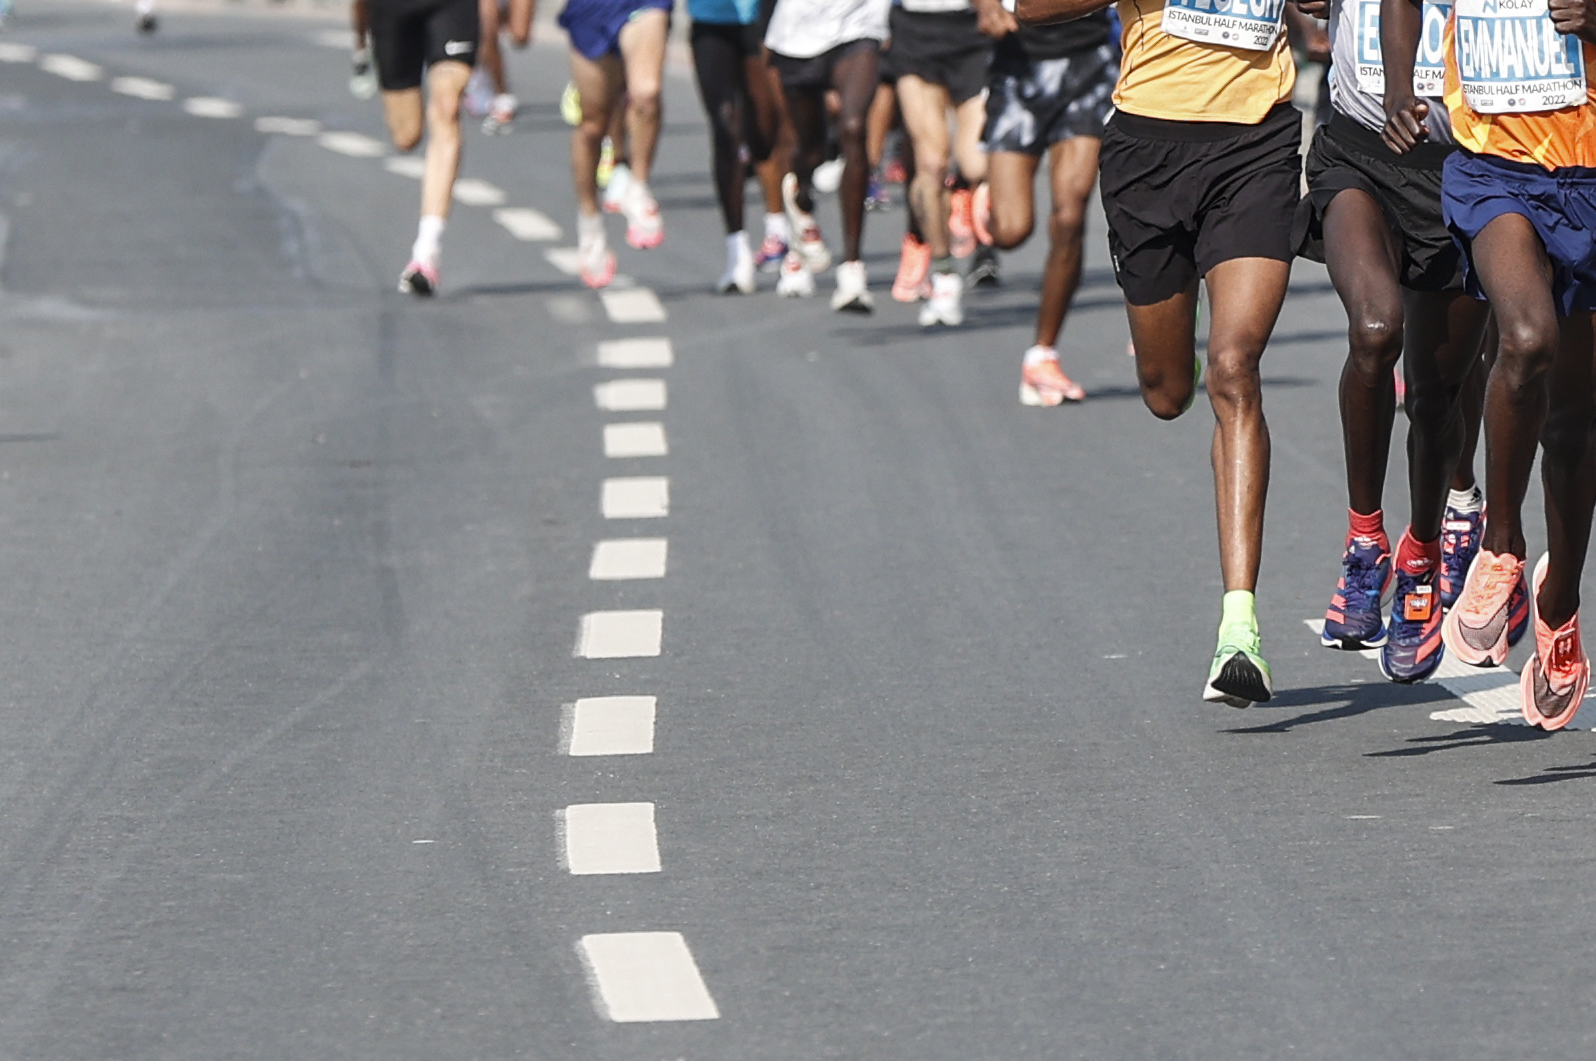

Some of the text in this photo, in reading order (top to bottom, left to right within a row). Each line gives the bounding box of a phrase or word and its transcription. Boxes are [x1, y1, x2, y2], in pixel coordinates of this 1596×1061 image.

[1499, 0, 1534, 10] KOLAY
[1168, 10, 1278, 36] ISTANBUL HALF MARATHON
[1459, 18, 1575, 79] EMMANUEL
[1360, 66, 1385, 78] ISTAN
[1414, 68, 1431, 80] ALF
[1496, 84, 1521, 95] HALF
[1522, 80, 1582, 94] MARATHON
[1542, 94, 1566, 106] 2022
